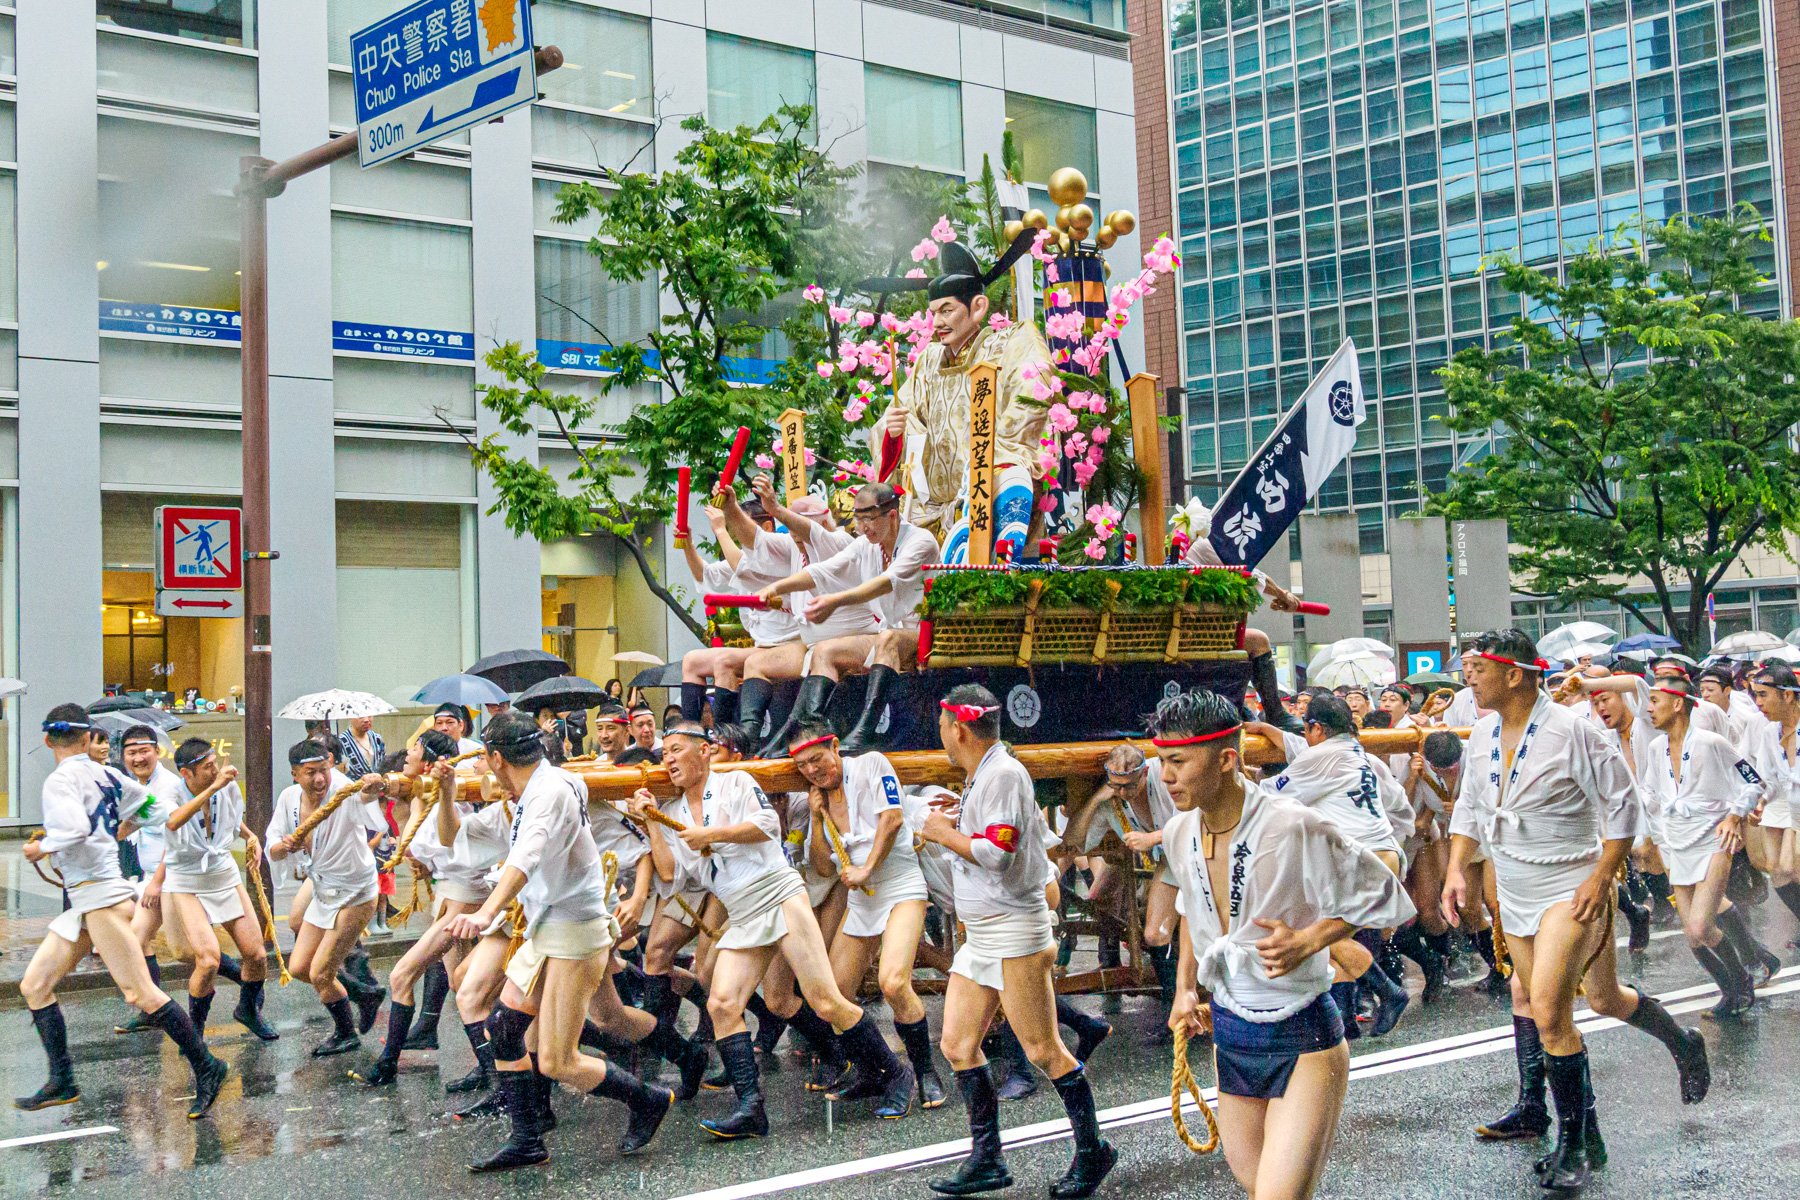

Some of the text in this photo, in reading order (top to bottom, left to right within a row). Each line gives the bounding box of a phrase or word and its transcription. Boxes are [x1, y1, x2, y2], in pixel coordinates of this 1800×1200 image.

[359, 0, 472, 83] 中央警察署
[365, 49, 475, 111] Chuo Police Sta.
[368, 122, 405, 153] 300m
[560, 353, 580, 365] SBI
[785, 421, 801, 491] 四番山笠
[178, 564, 216, 576] 横断禁止
[1456, 523, 1468, 576] アクロス福岡
[1416, 656, 1434, 673] P
